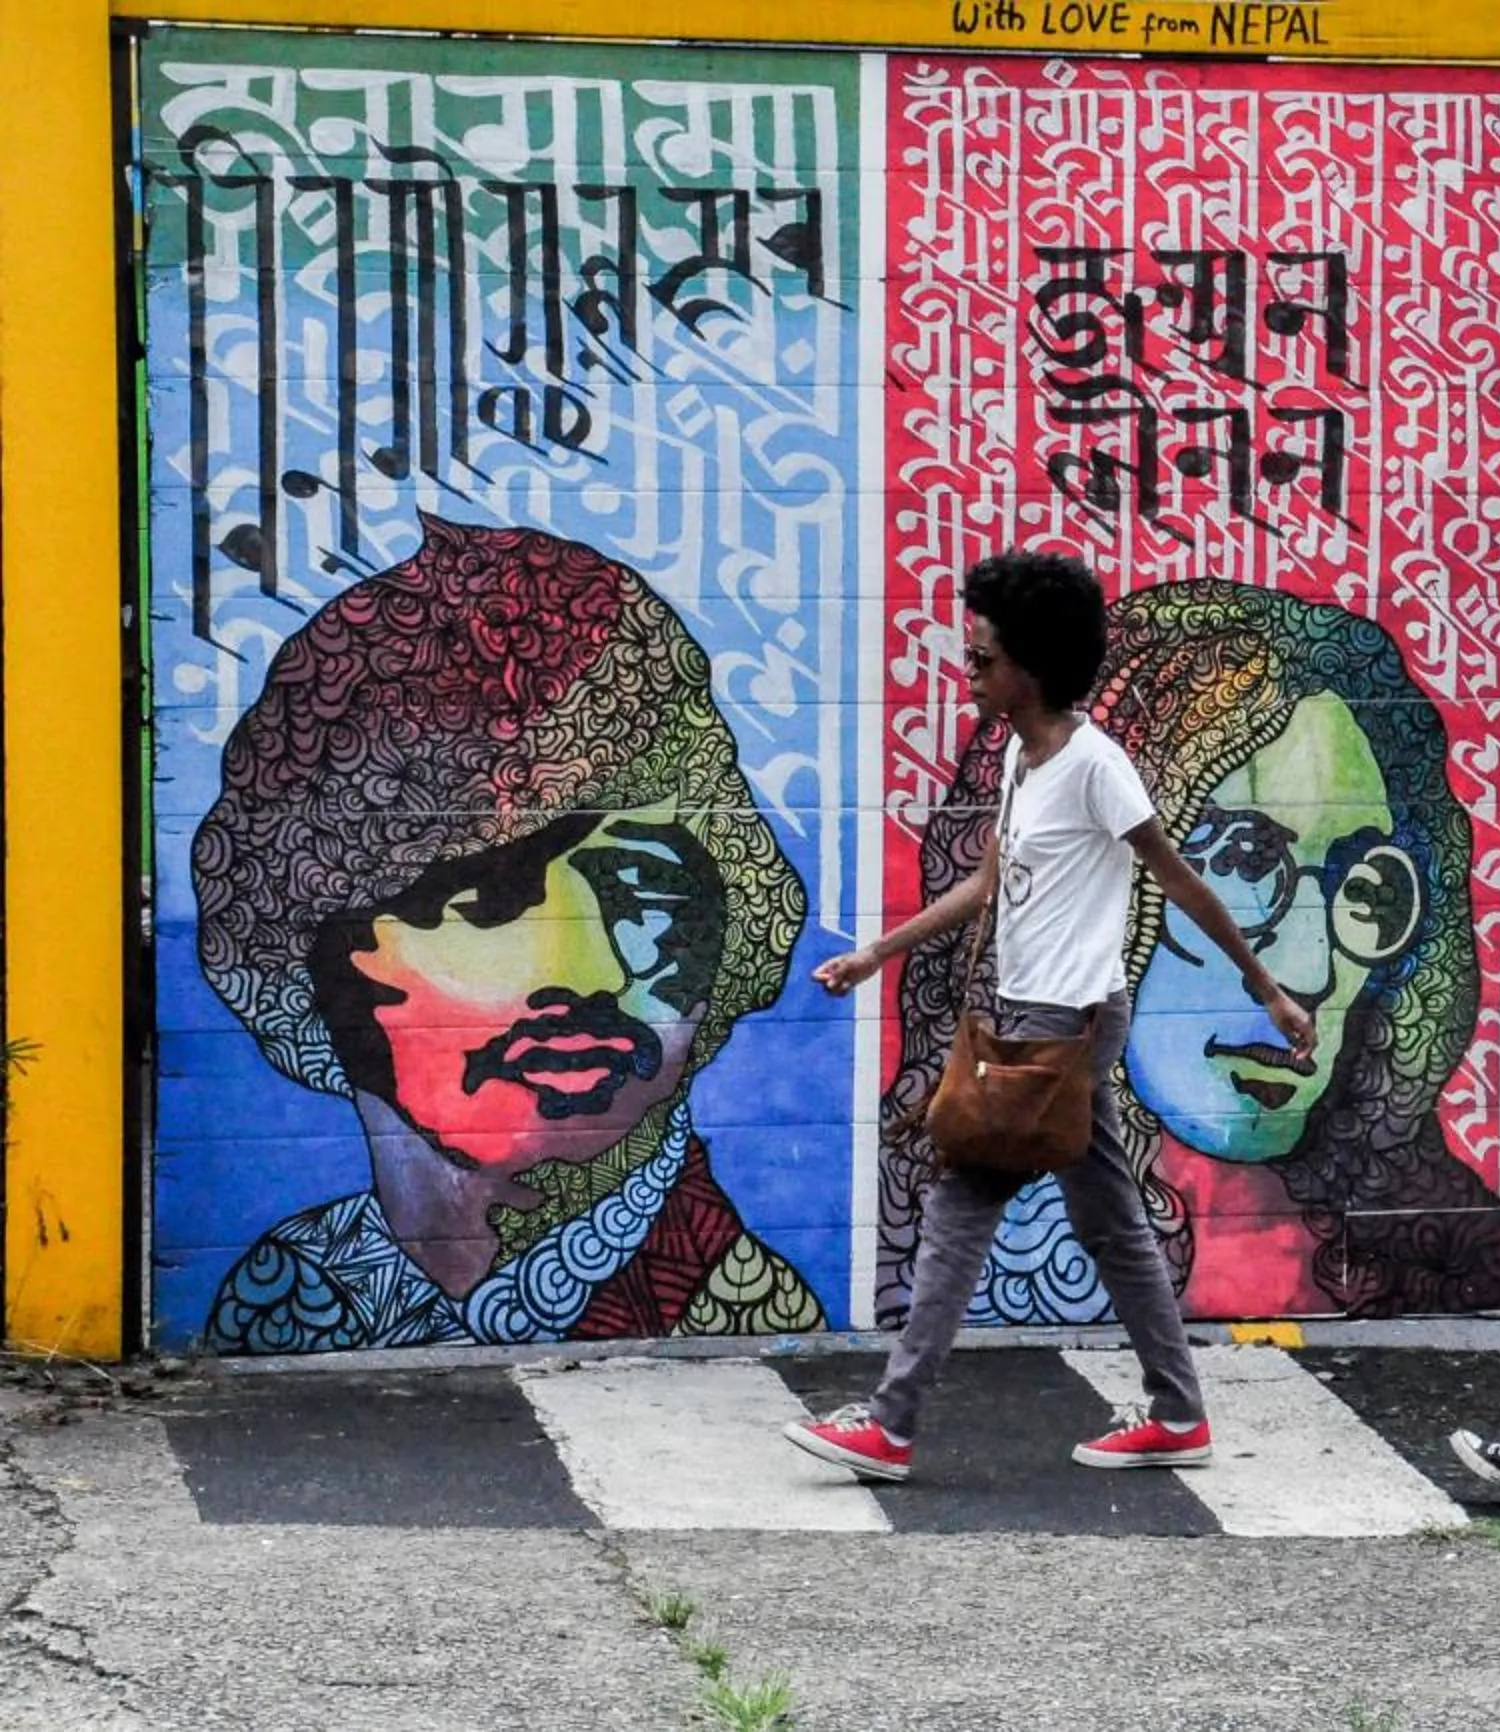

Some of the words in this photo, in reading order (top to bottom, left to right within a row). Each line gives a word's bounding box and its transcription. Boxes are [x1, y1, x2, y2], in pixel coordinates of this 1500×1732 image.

[952, 1, 1025, 34] With
[1041, 1, 1129, 34] LOVE
[1140, 13, 1200, 44] from
[1210, 1, 1329, 45] NEPAL
